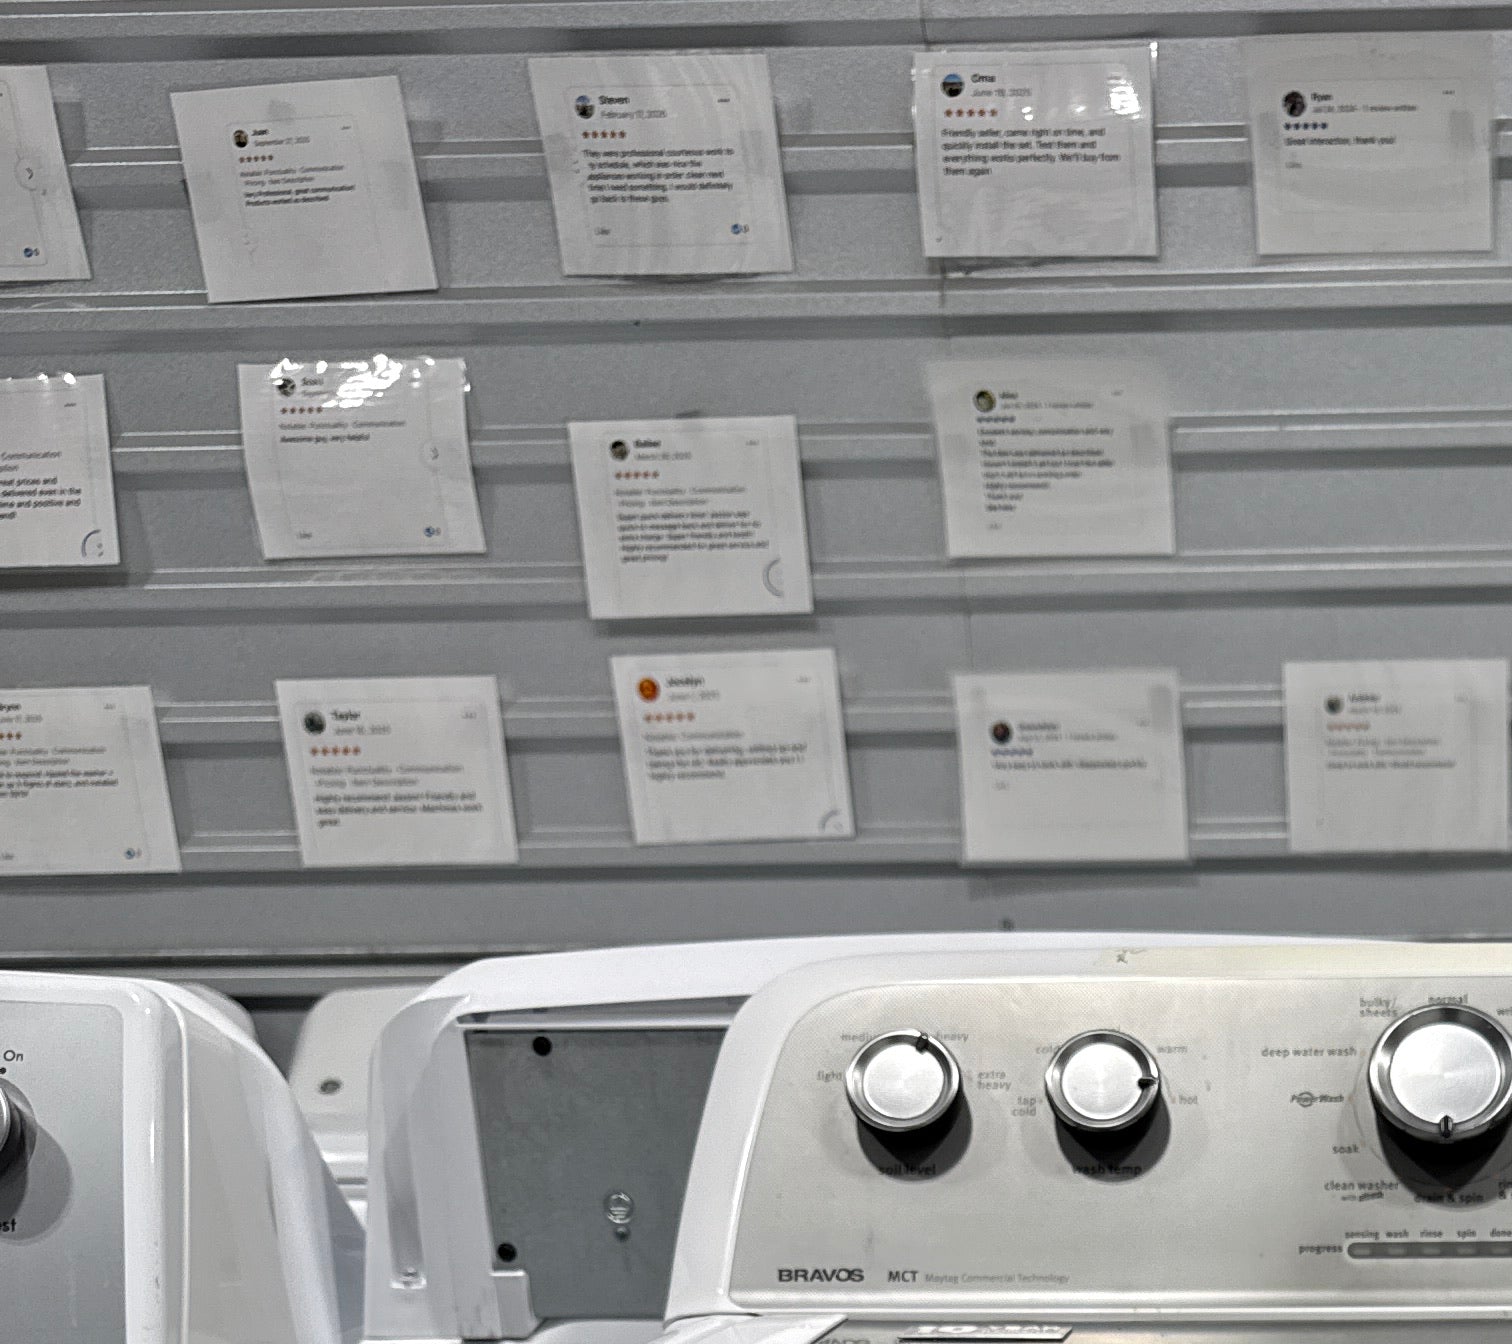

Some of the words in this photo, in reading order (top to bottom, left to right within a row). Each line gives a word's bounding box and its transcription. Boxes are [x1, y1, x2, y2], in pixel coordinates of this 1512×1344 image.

[3, 1050, 23, 1062] On
[1261, 1046, 1290, 1058] deep
[1292, 1048, 1324, 1057] water
[1327, 1046, 1357, 1057] wash
[1332, 1144, 1359, 1154] soak
[879, 1164, 900, 1176] soil
[905, 1164, 937, 1176] level
[1109, 1165, 1142, 1176] temp
[1324, 1180, 1355, 1191] clean
[1357, 1180, 1399, 1191] washer
[1420, 1229, 1443, 1238] rinse
[1456, 1229, 1477, 1240] spin
[1489, 1228, 1512, 1238] done
[1298, 1245, 1343, 1255] progress
[778, 1268, 865, 1283] BRAVOS
[888, 1270, 919, 1283] MCT
[925, 1273, 959, 1284] Maytag
[962, 1273, 1015, 1282] Commercial
[1018, 1273, 1070, 1284] Technology
